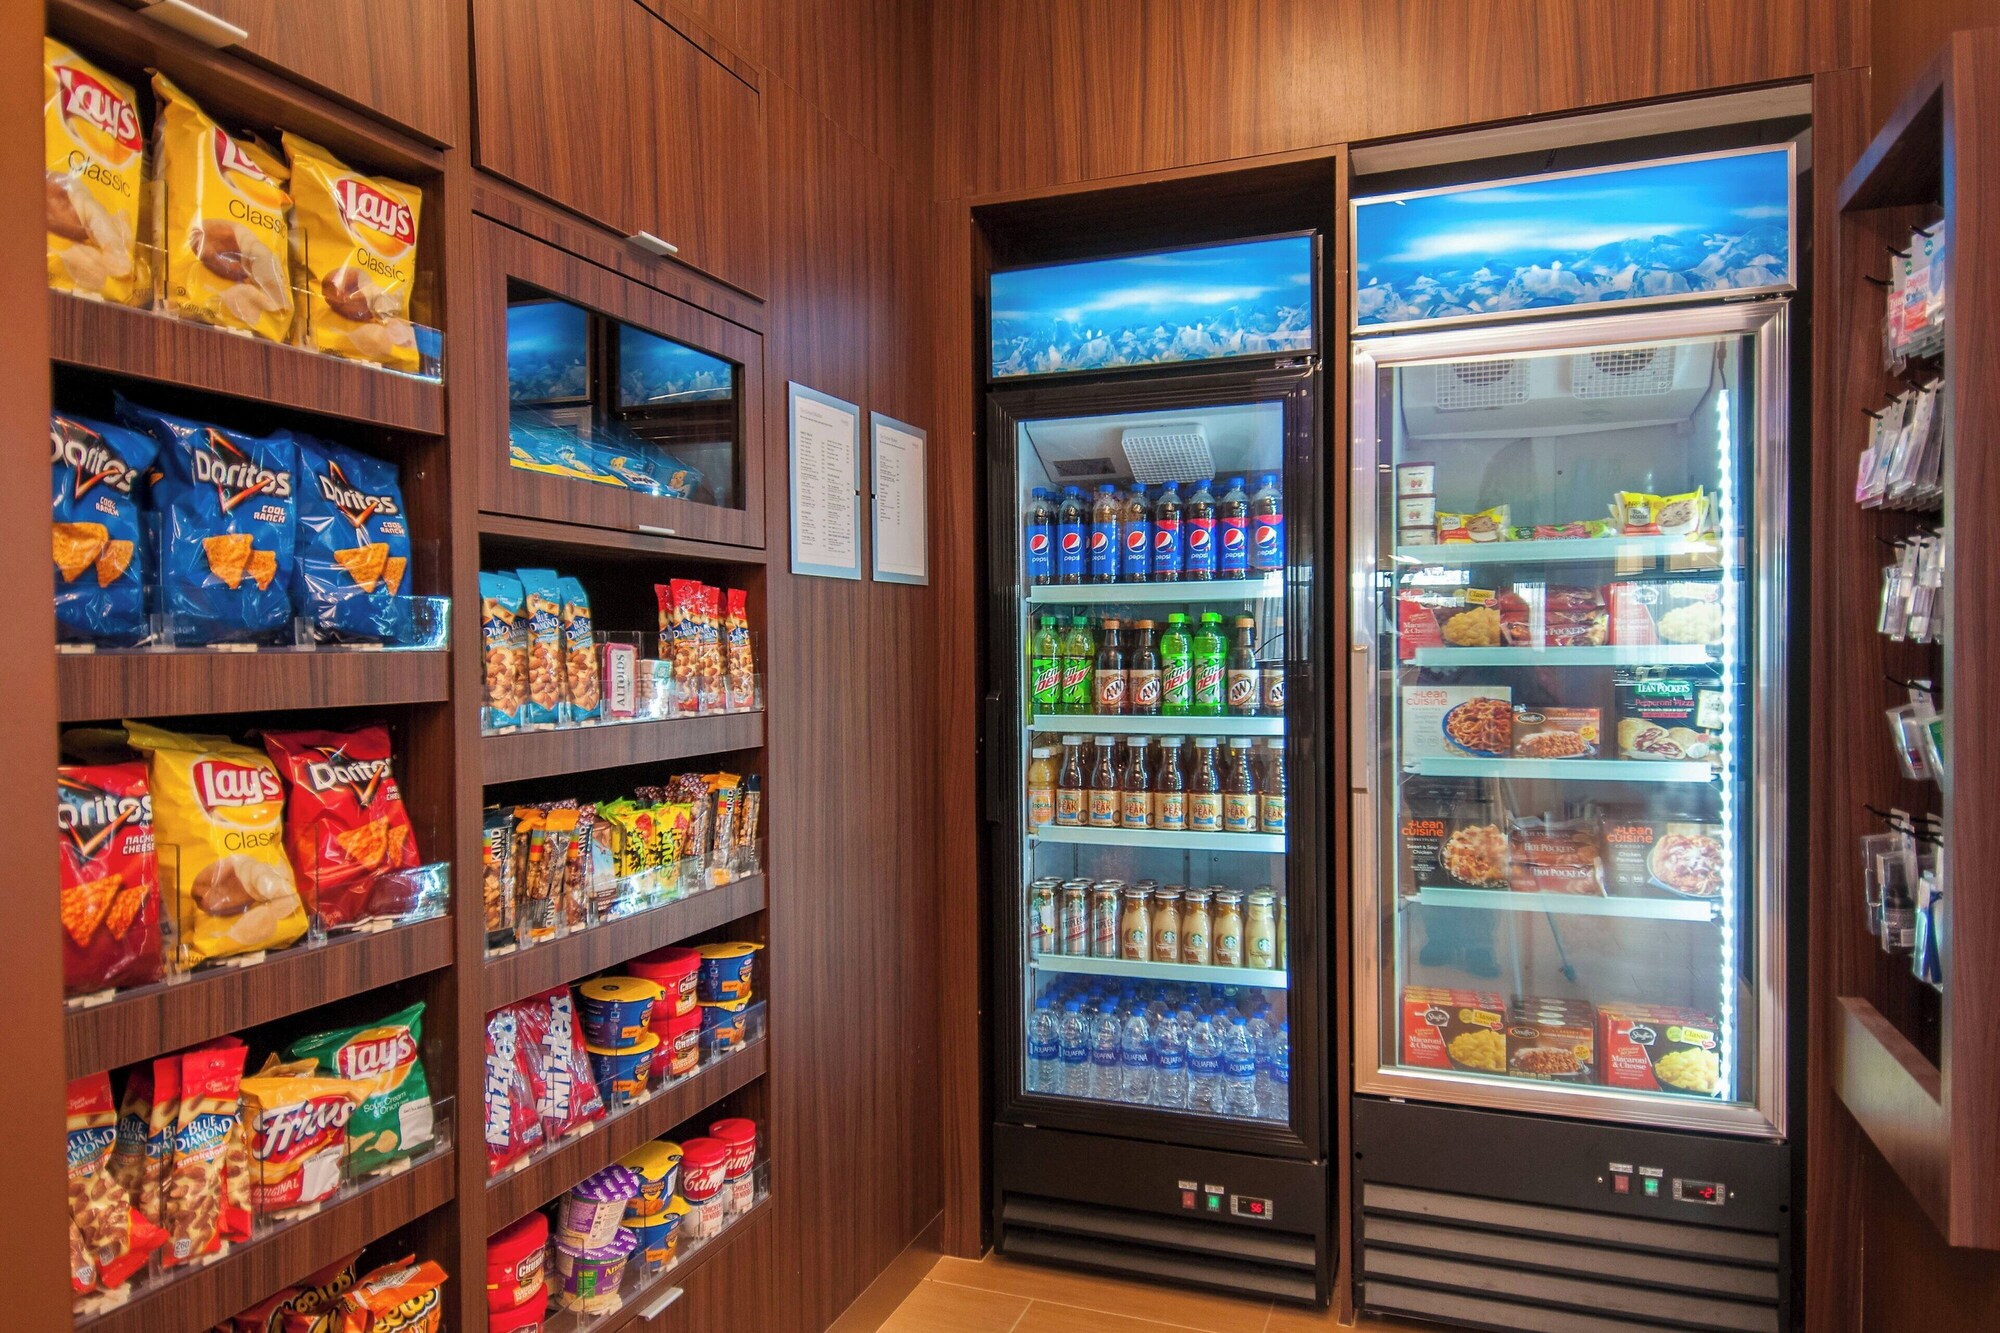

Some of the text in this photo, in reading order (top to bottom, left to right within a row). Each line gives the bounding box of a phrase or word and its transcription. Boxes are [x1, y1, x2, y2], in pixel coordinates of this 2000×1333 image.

[60, 68, 136, 140] Lay's
[68, 150, 131, 198] Classic
[346, 181, 410, 237] Lay's
[357, 247, 406, 283] Classic
[195, 450, 291, 496] Doritos
[319, 475, 398, 514] Doritos
[253, 511, 286, 523] RANCH
[261, 504, 286, 515] COOL
[379, 527, 405, 535] RANCH
[383, 521, 402, 530] COOL
[1551, 626, 1586, 636] POCKETS
[616, 653, 626, 707] ALTOIDS
[1657, 683, 1690, 693] POCKETS
[1635, 699, 1695, 707] Pepperoni Pizza
[202, 763, 280, 807] Lay's
[491, 828, 501, 862] KIND
[578, 826, 587, 857] KIND
[1551, 868, 1588, 878] POCKETS
[1409, 1035, 1442, 1046] Macaroni
[1415, 1042, 1441, 1051] Cheese
[347, 1032, 411, 1080] Lay's
[1192, 1060, 1218, 1068] AQUAFINA
[1611, 1054, 1648, 1065] Macaroni
[1229, 1062, 1255, 1072] AQUAFINA
[1619, 1062, 1647, 1071] Cheese
[384, 1090, 407, 1107] Cream
[379, 1101, 402, 1116] Onion
[121, 1117, 144, 1134] BLUE
[188, 1114, 217, 1136] BLUE
[253, 1099, 357, 1160] Fritos
[174, 1118, 233, 1151] DIAMOND
[175, 1241, 190, 1250] 260
